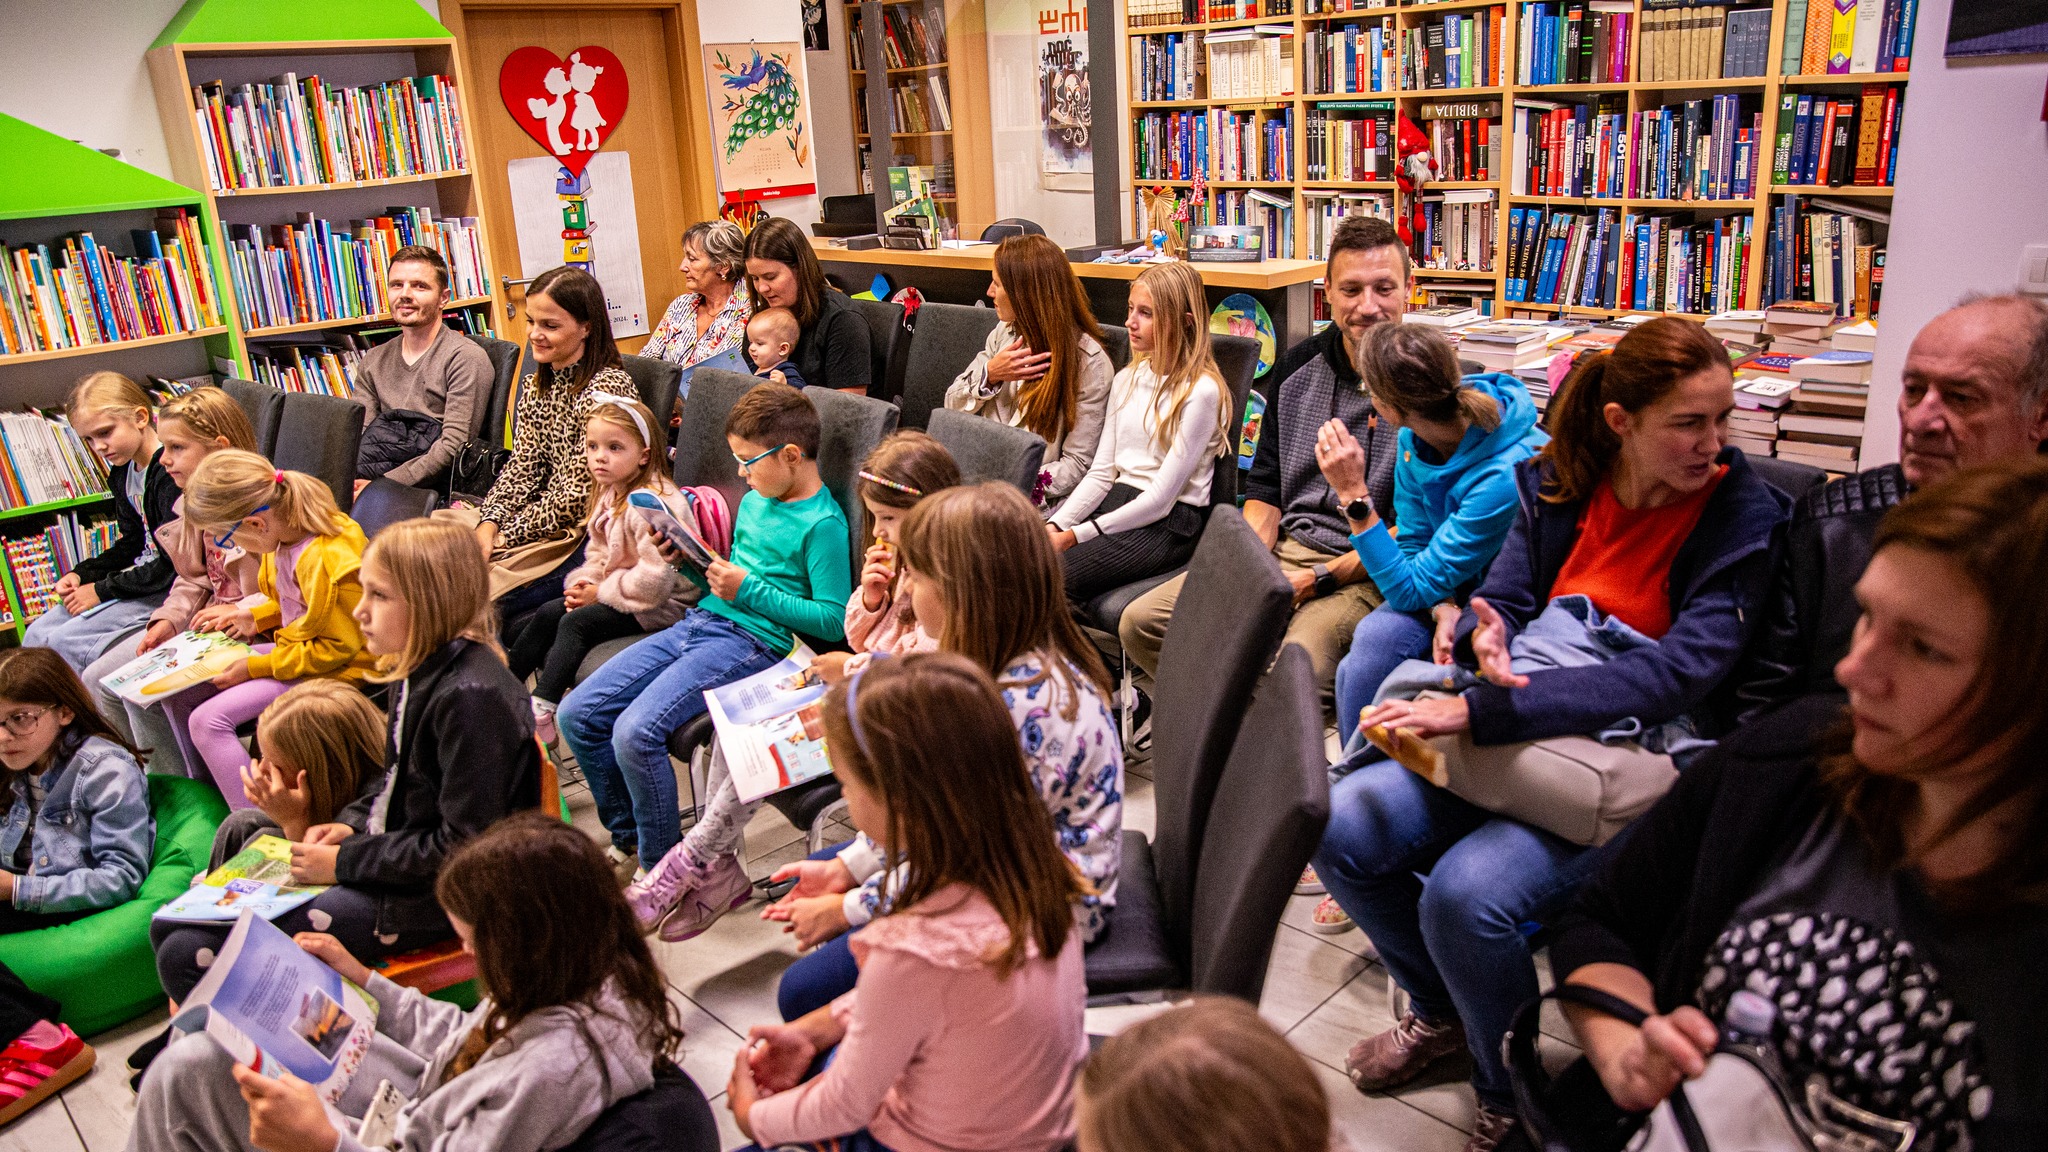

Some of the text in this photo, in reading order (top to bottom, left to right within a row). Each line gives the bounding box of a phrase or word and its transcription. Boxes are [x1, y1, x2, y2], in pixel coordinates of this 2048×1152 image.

[1435, 104, 1478, 117] BIBLIJA
[1617, 134, 1626, 160] 501
[1795, 123, 1805, 156] POVIJEST
[1812, 122, 1822, 156] POVIJEST
[1521, 244, 1531, 267] SVIJETA
